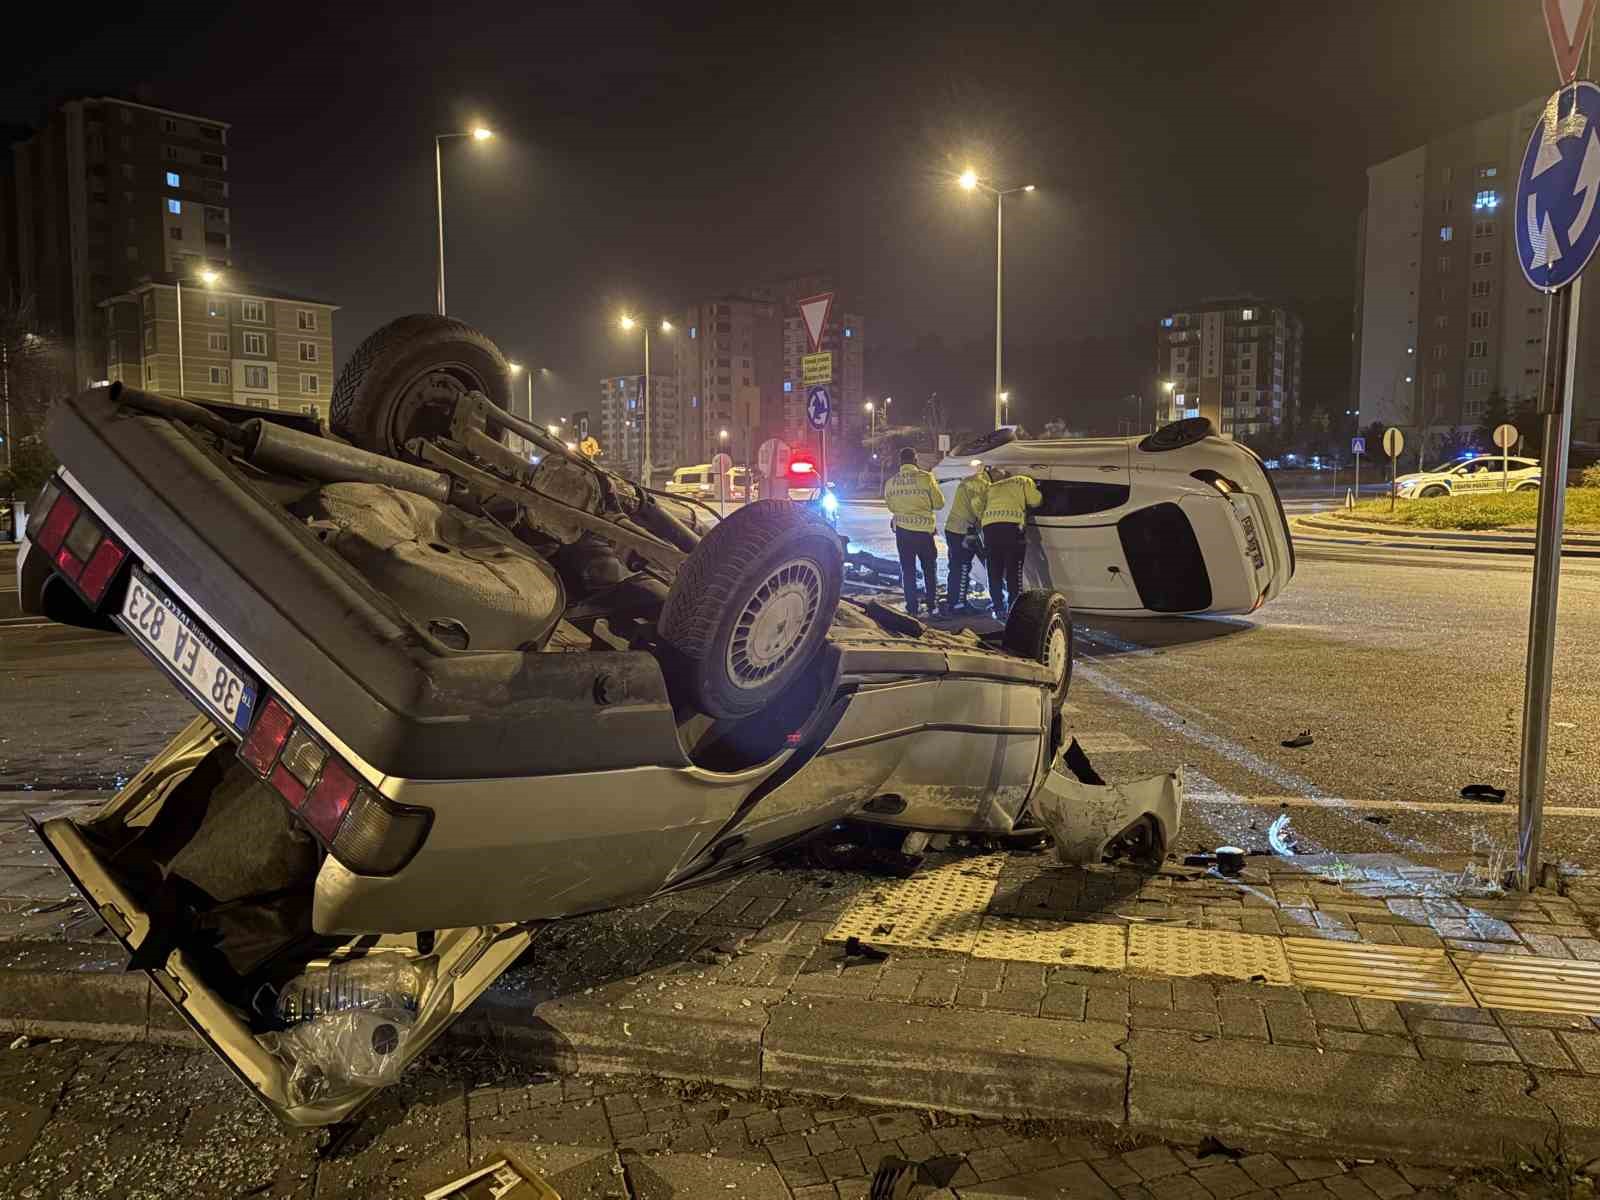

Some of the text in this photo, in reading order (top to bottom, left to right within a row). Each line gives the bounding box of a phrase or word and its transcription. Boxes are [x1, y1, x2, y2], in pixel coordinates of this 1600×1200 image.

[128, 585, 166, 641] 823
[172, 625, 201, 678] EA
[211, 666, 240, 714] 38
[242, 692, 251, 708] TR
